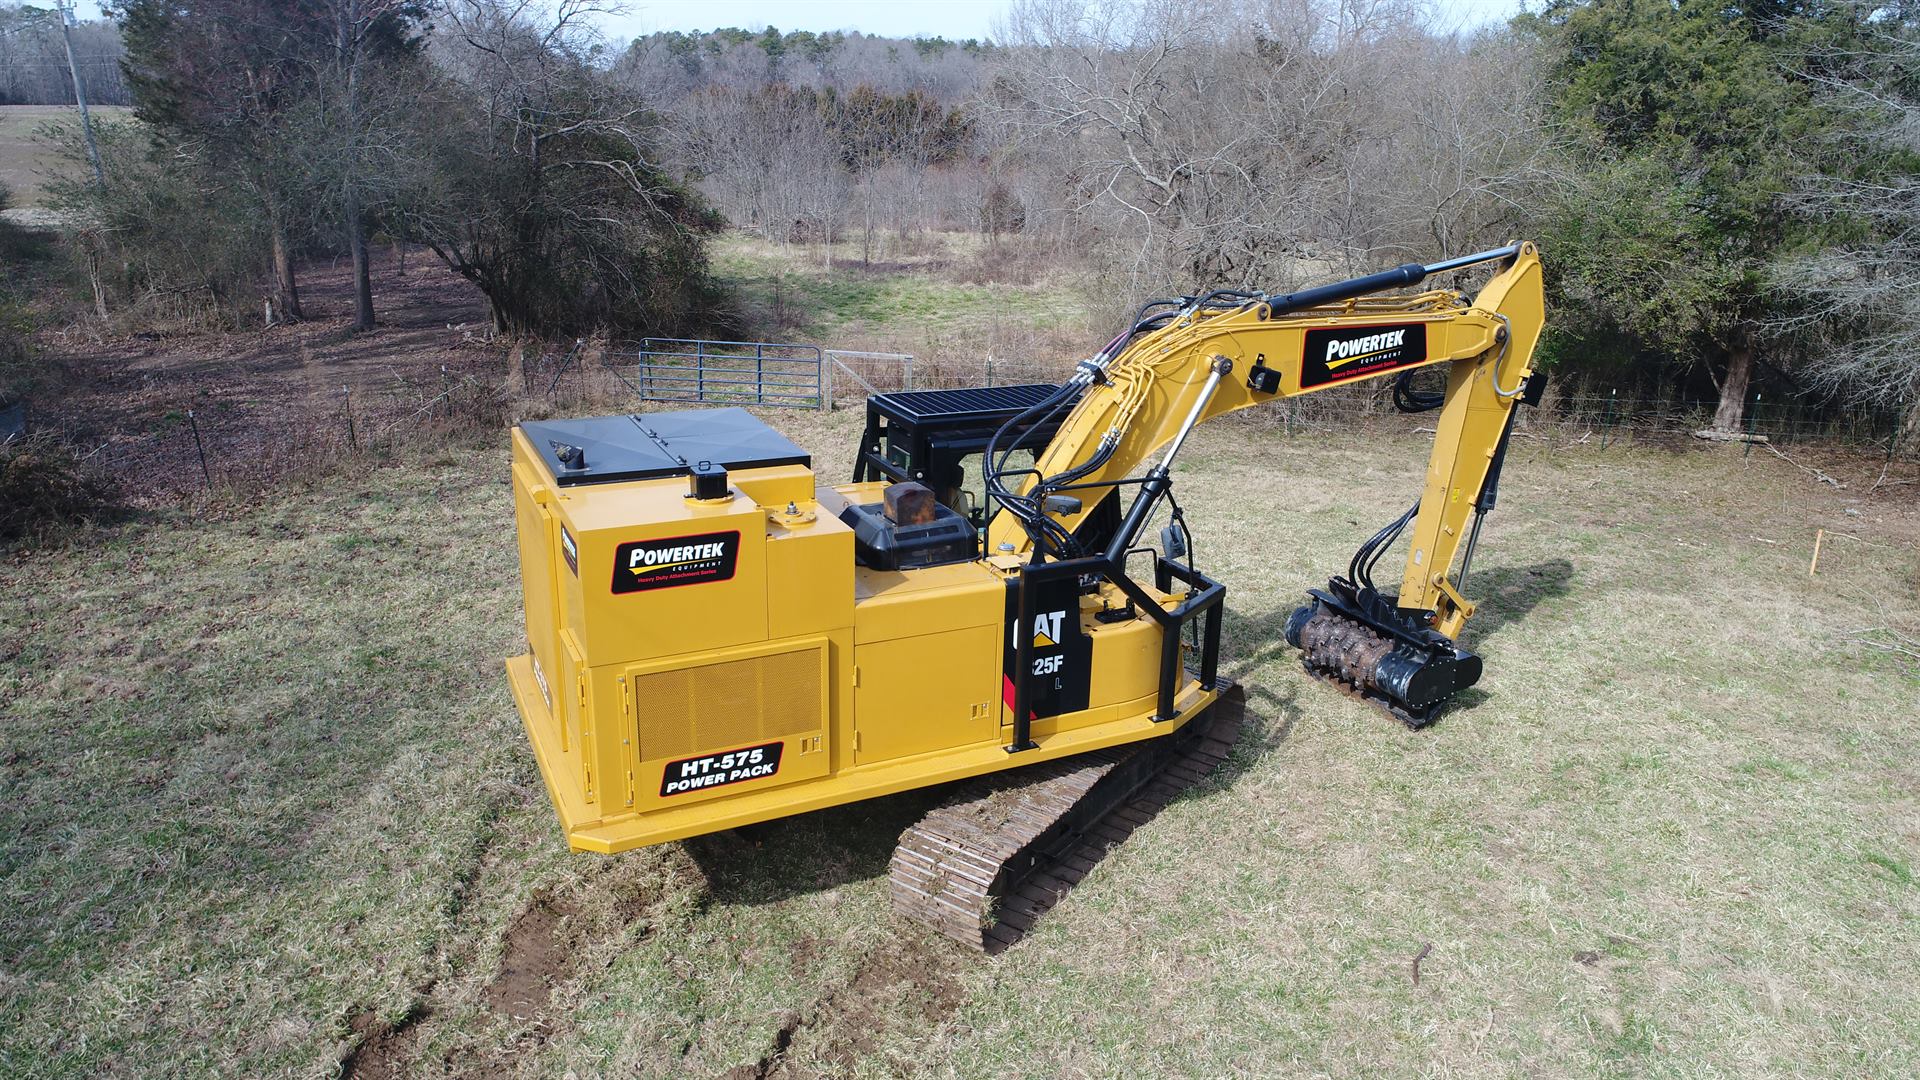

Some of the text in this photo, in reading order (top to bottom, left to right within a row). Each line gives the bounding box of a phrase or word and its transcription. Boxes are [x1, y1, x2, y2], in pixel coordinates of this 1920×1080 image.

[1360, 351, 1401, 364] EQUIPMENT
[1331, 371, 1346, 379] Heavy
[1358, 363, 1383, 373] Attachment
[669, 571, 700, 579] Attachment
[700, 568, 717, 576] Series
[672, 561, 721, 572] EQUIPMENT
[1031, 654, 1064, 676] 25F
[681, 749, 763, 777] HT-575
[666, 762, 774, 793] POWER PACK
